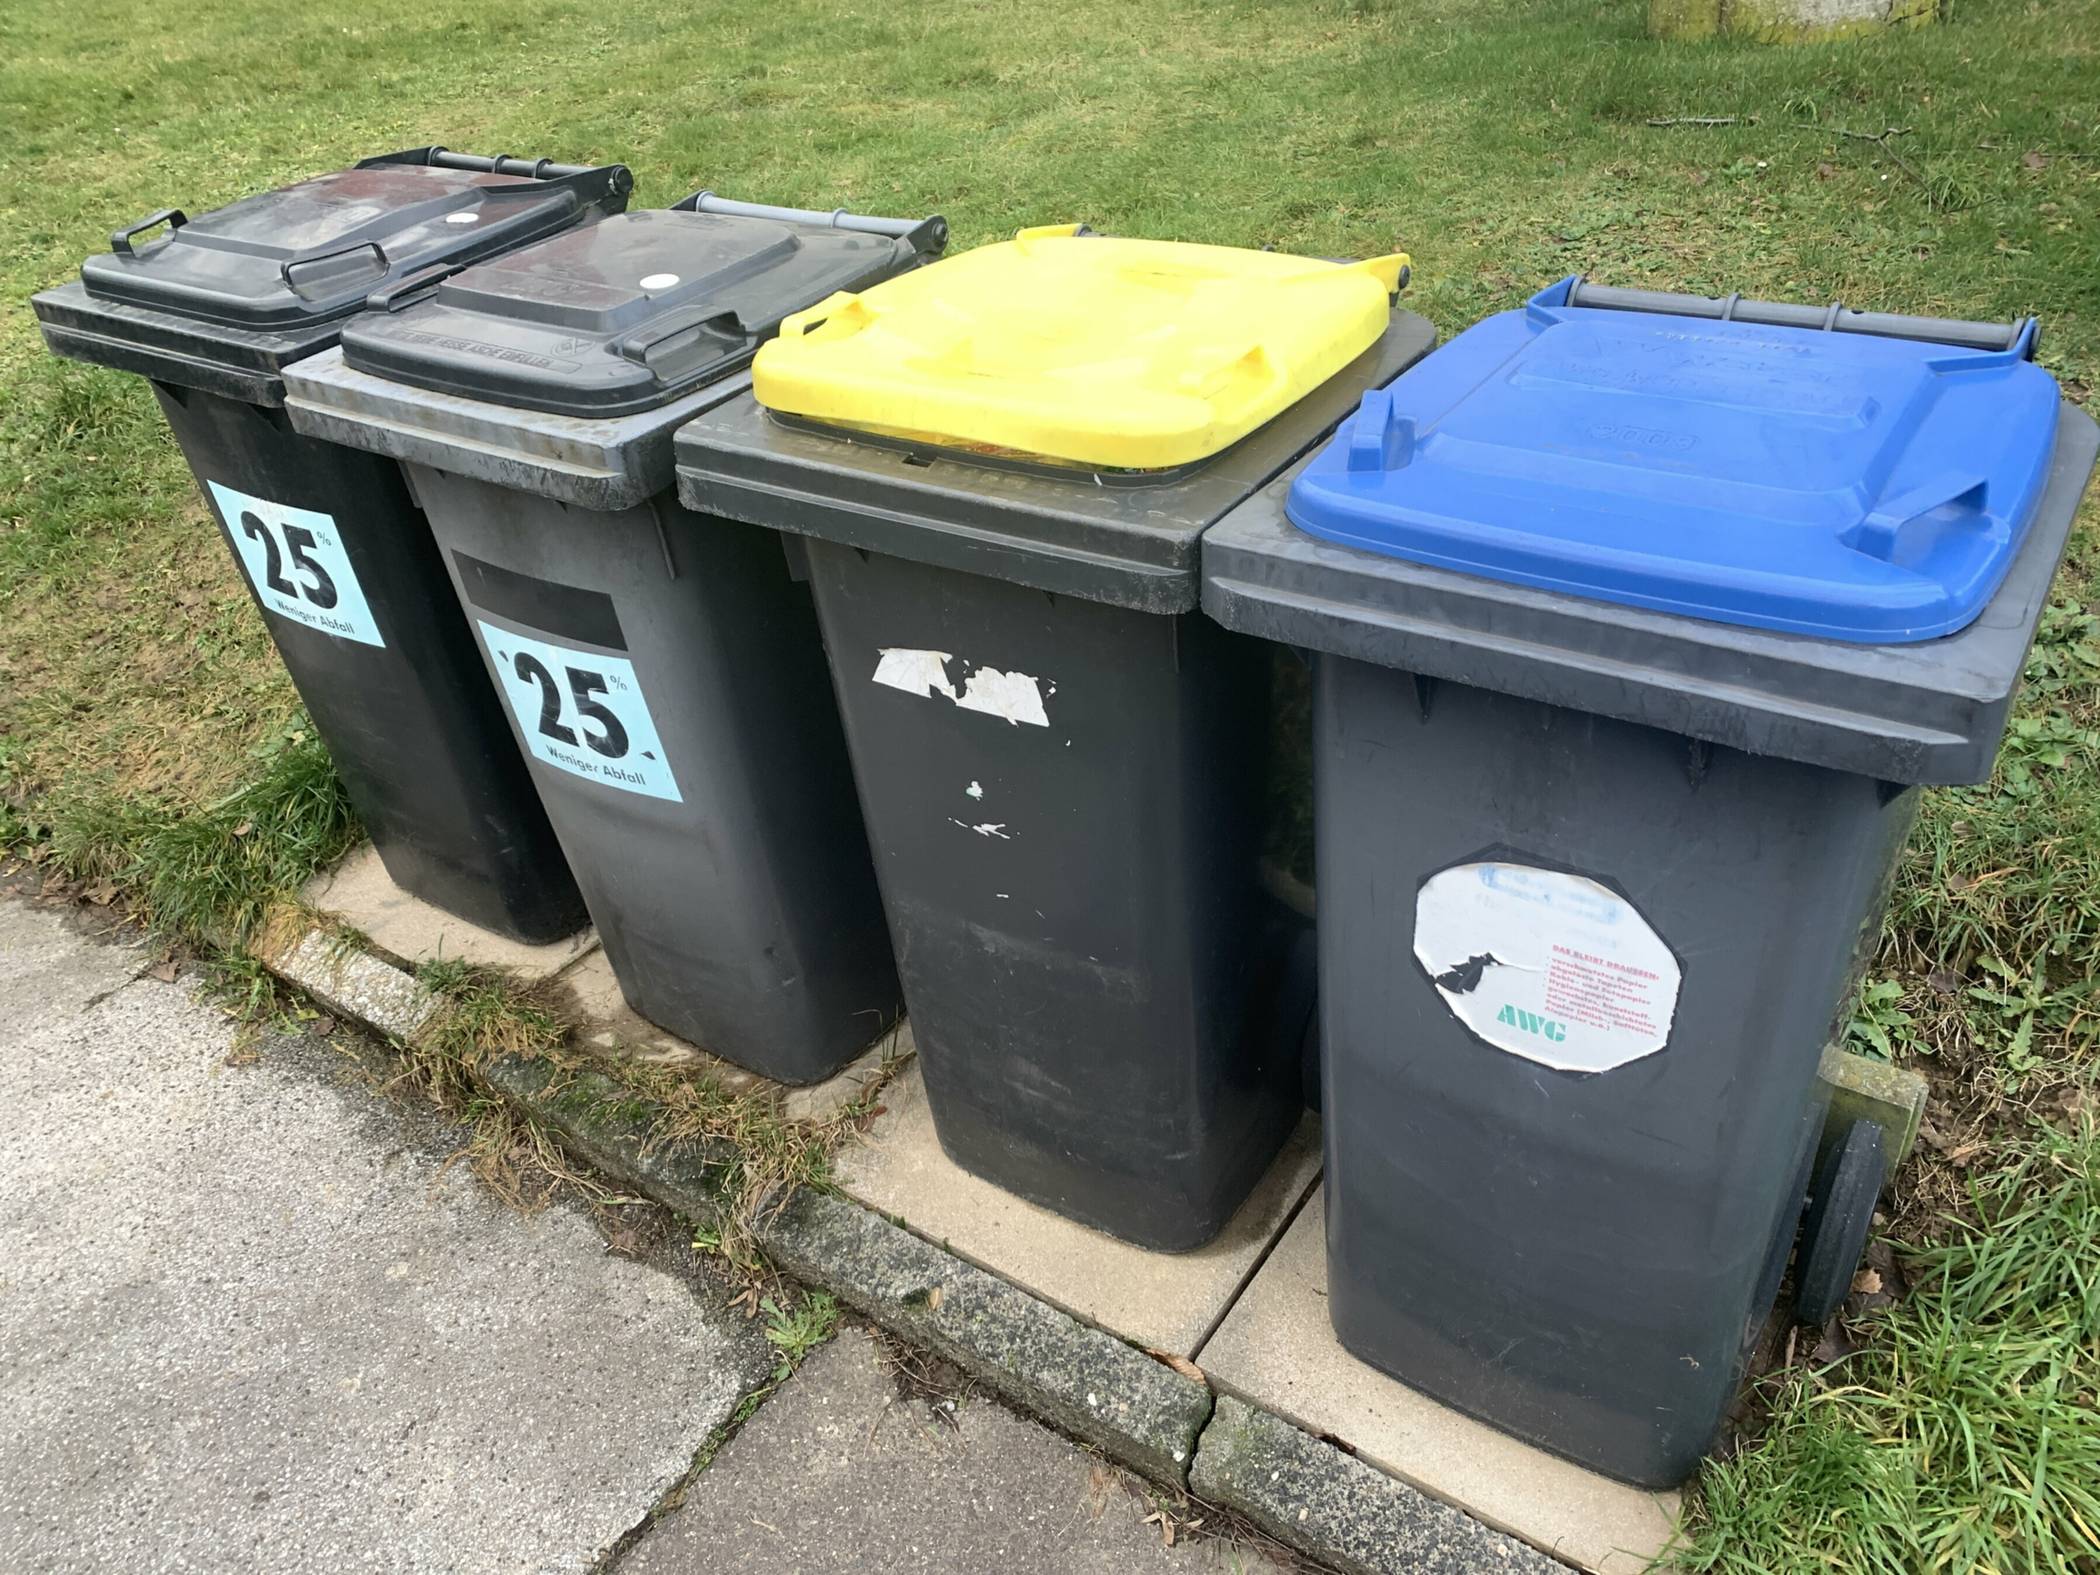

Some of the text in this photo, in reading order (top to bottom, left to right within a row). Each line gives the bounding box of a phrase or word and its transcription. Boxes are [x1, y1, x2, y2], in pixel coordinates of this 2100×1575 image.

[275, 599, 355, 635] Weniger Abfall
[546, 745, 647, 785] Weniger Abfall
[1553, 944, 1570, 955] DAS
[1574, 951, 1603, 965] BLEIBT
[1583, 982, 1599, 991] und
[1617, 977, 1648, 990] Papier
[1497, 1003, 1567, 1043] AWG
